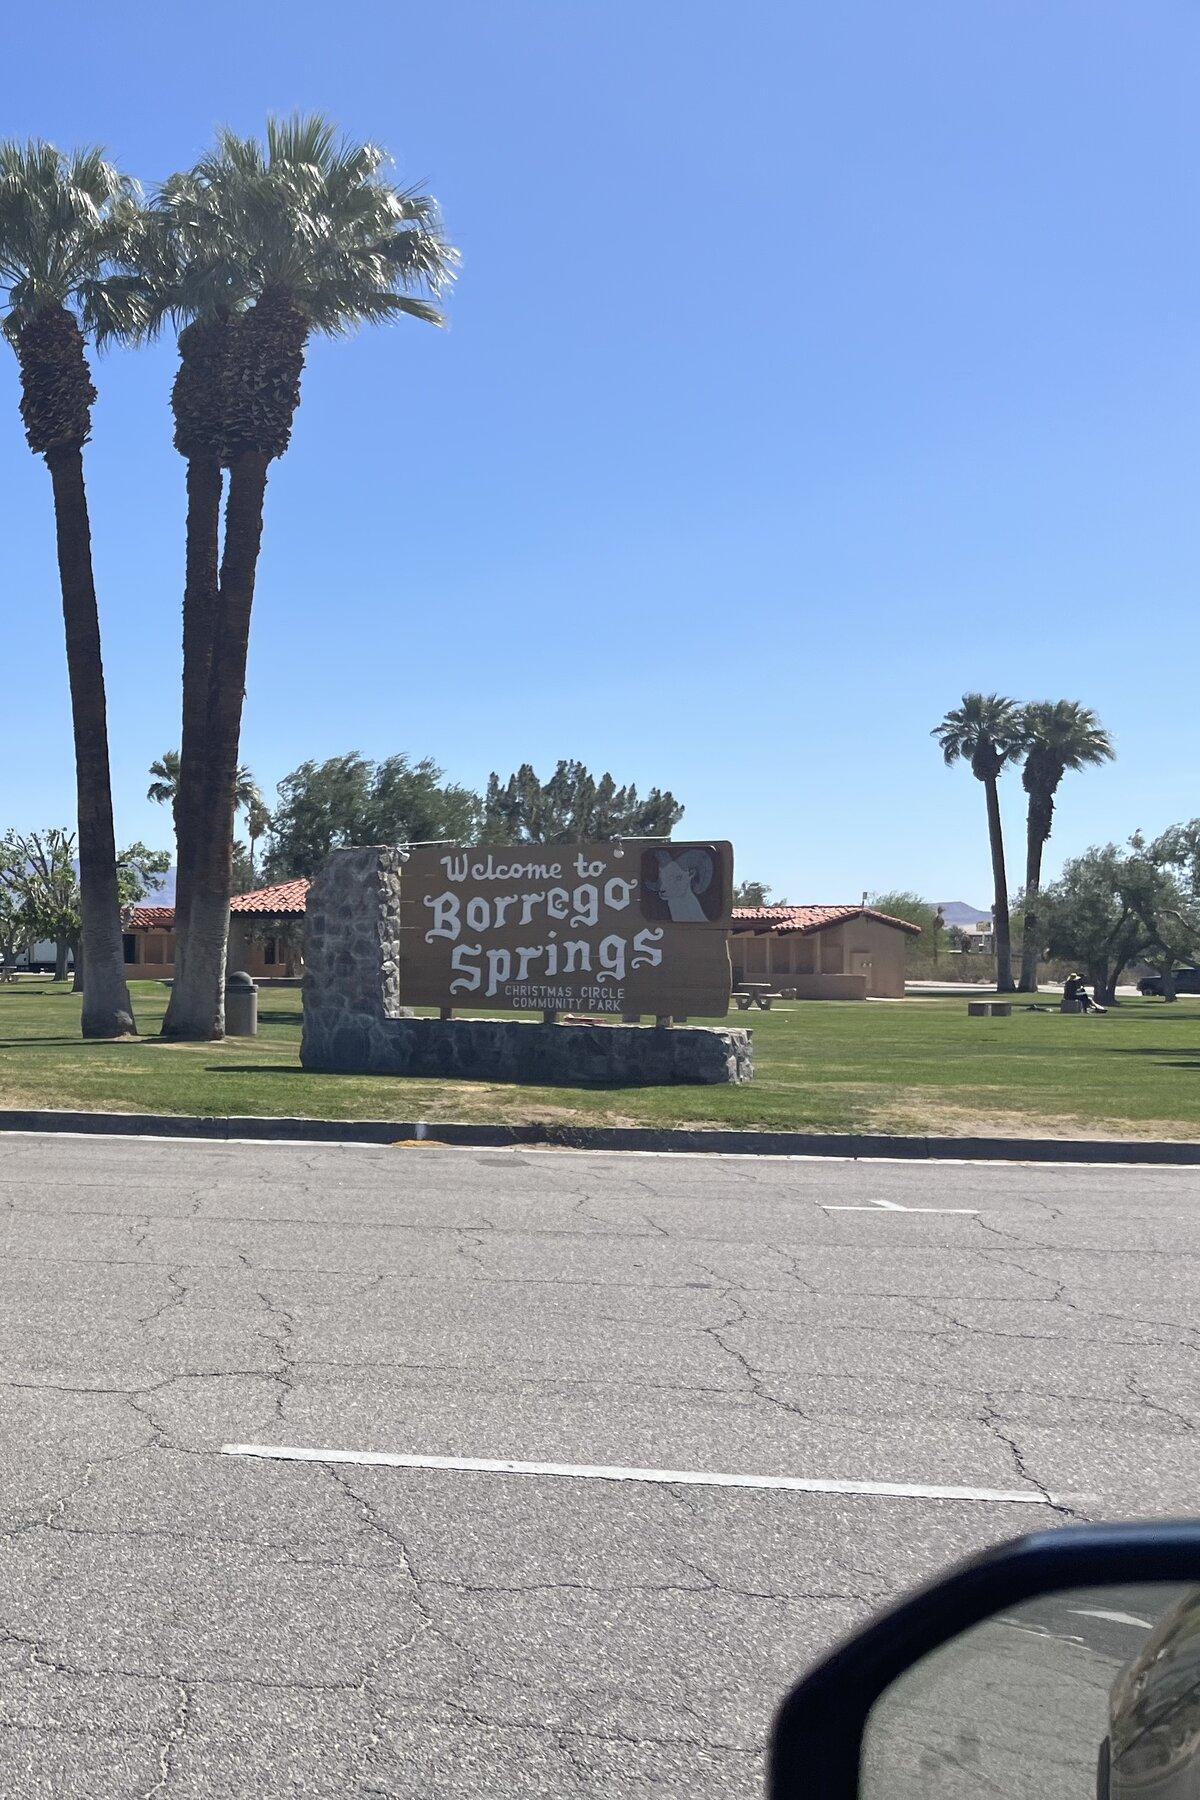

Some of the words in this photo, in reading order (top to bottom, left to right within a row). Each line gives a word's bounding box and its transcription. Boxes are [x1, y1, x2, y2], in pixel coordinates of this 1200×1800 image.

[440, 852, 563, 883] Welcome
[573, 852, 607, 878] to
[423, 877, 638, 943] Borrego
[449, 927, 664, 997] Springs
[504, 985, 572, 997] CHRISTMAS
[580, 986, 625, 999] CIRCLE
[512, 997, 583, 1010] COMMUNITY
[588, 999, 621, 1011] PARK
